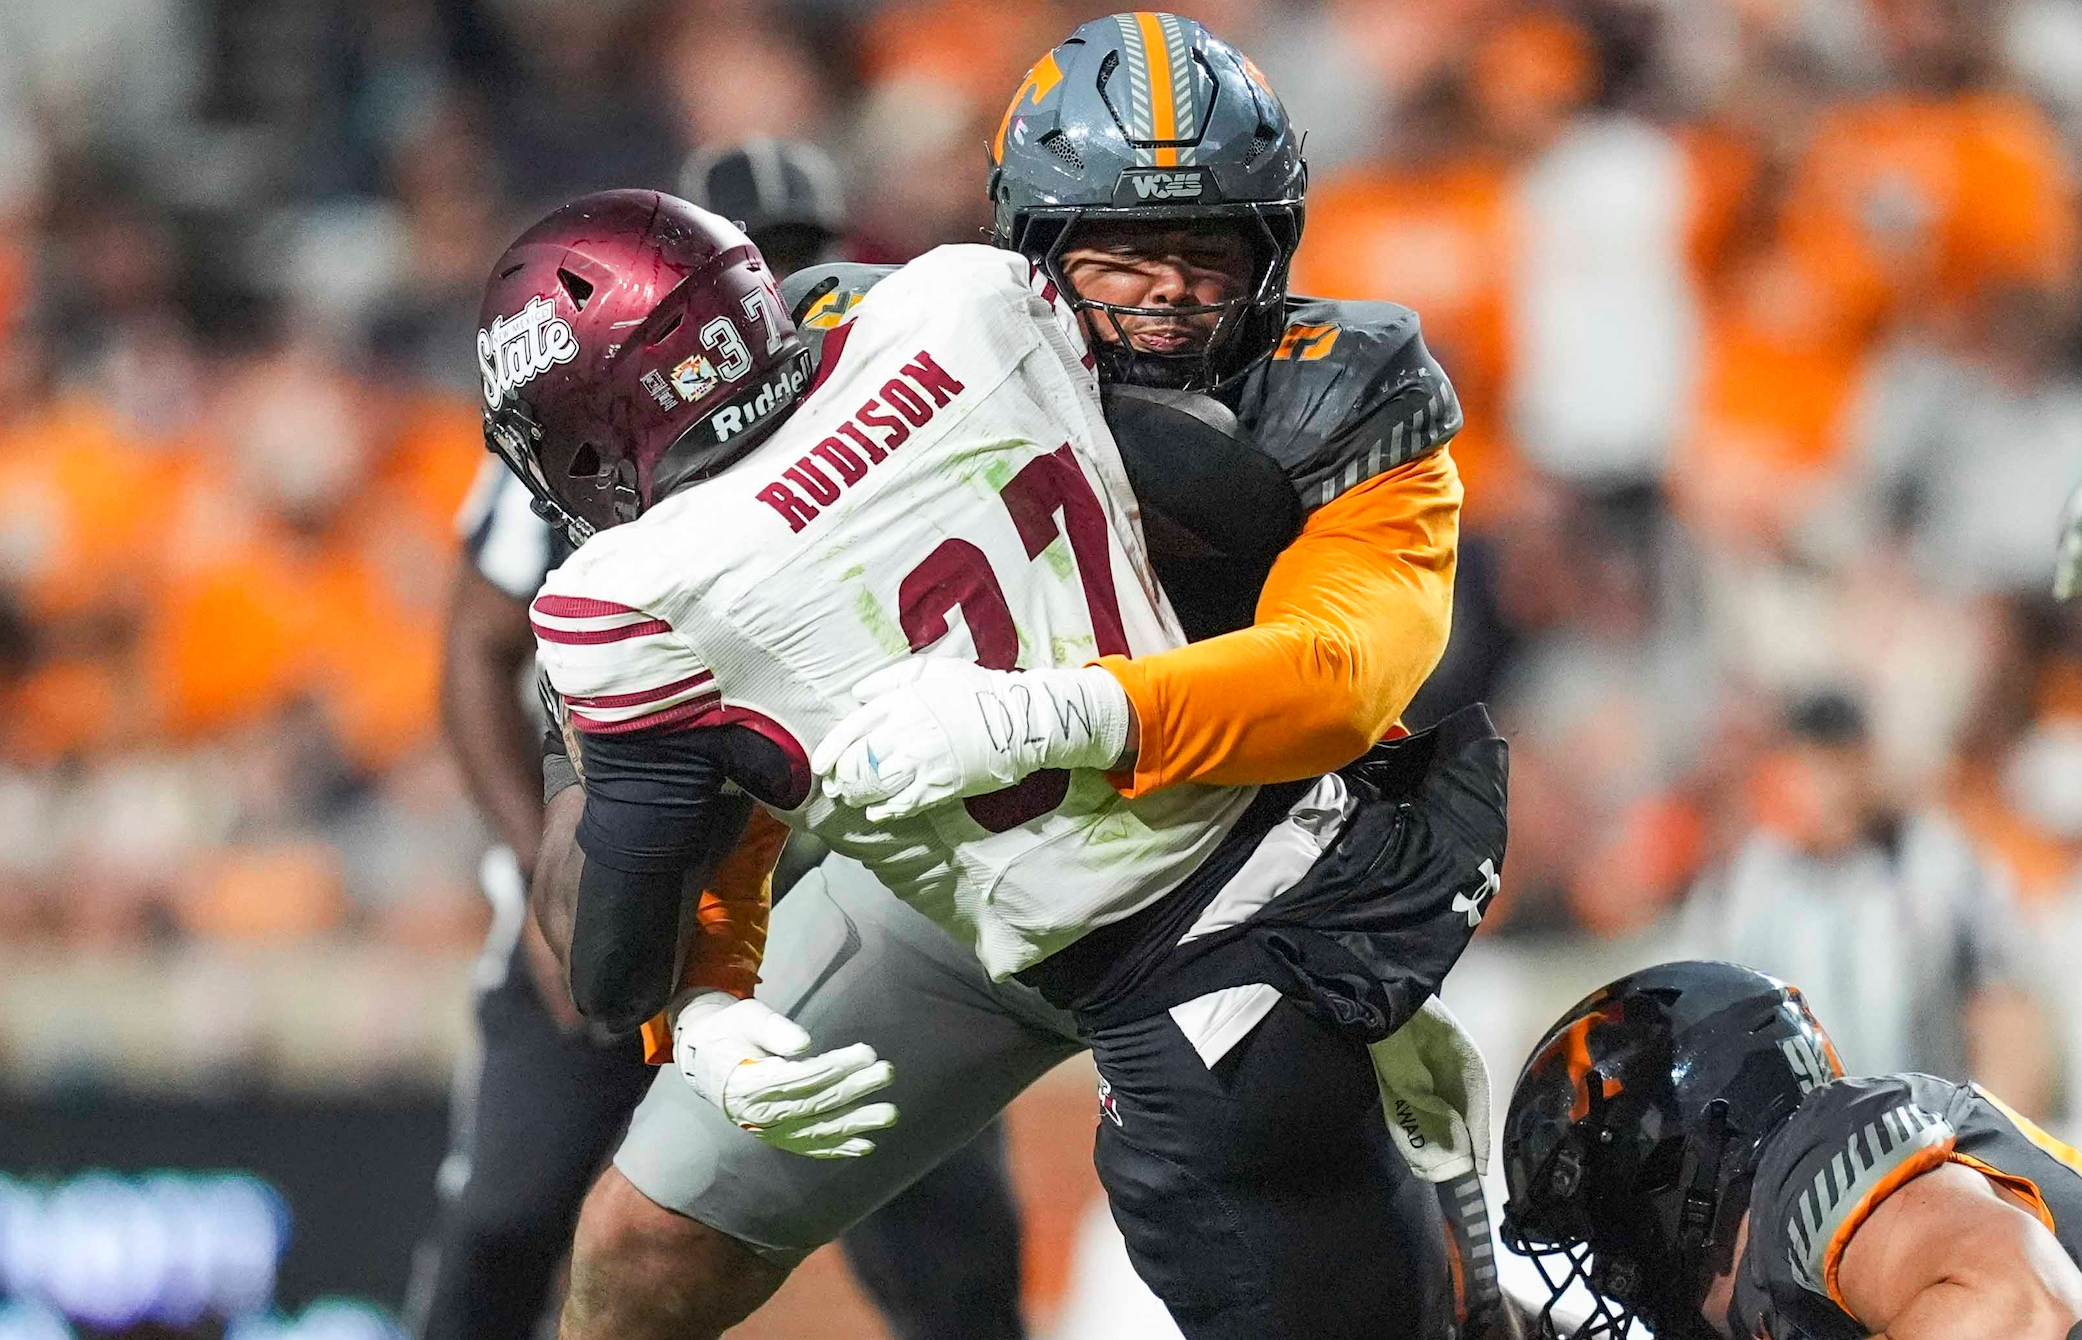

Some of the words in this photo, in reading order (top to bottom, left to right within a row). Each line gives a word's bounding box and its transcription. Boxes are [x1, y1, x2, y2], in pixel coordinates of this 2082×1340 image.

[1132, 173, 1203, 199] VOLS
[478, 296, 580, 412] State
[512, 307, 550, 332] MEXICO
[700, 287, 783, 383] 37
[711, 352, 811, 443] Riddell
[755, 350, 966, 534] RUDISON
[1395, 1099, 1425, 1149] AWAD
